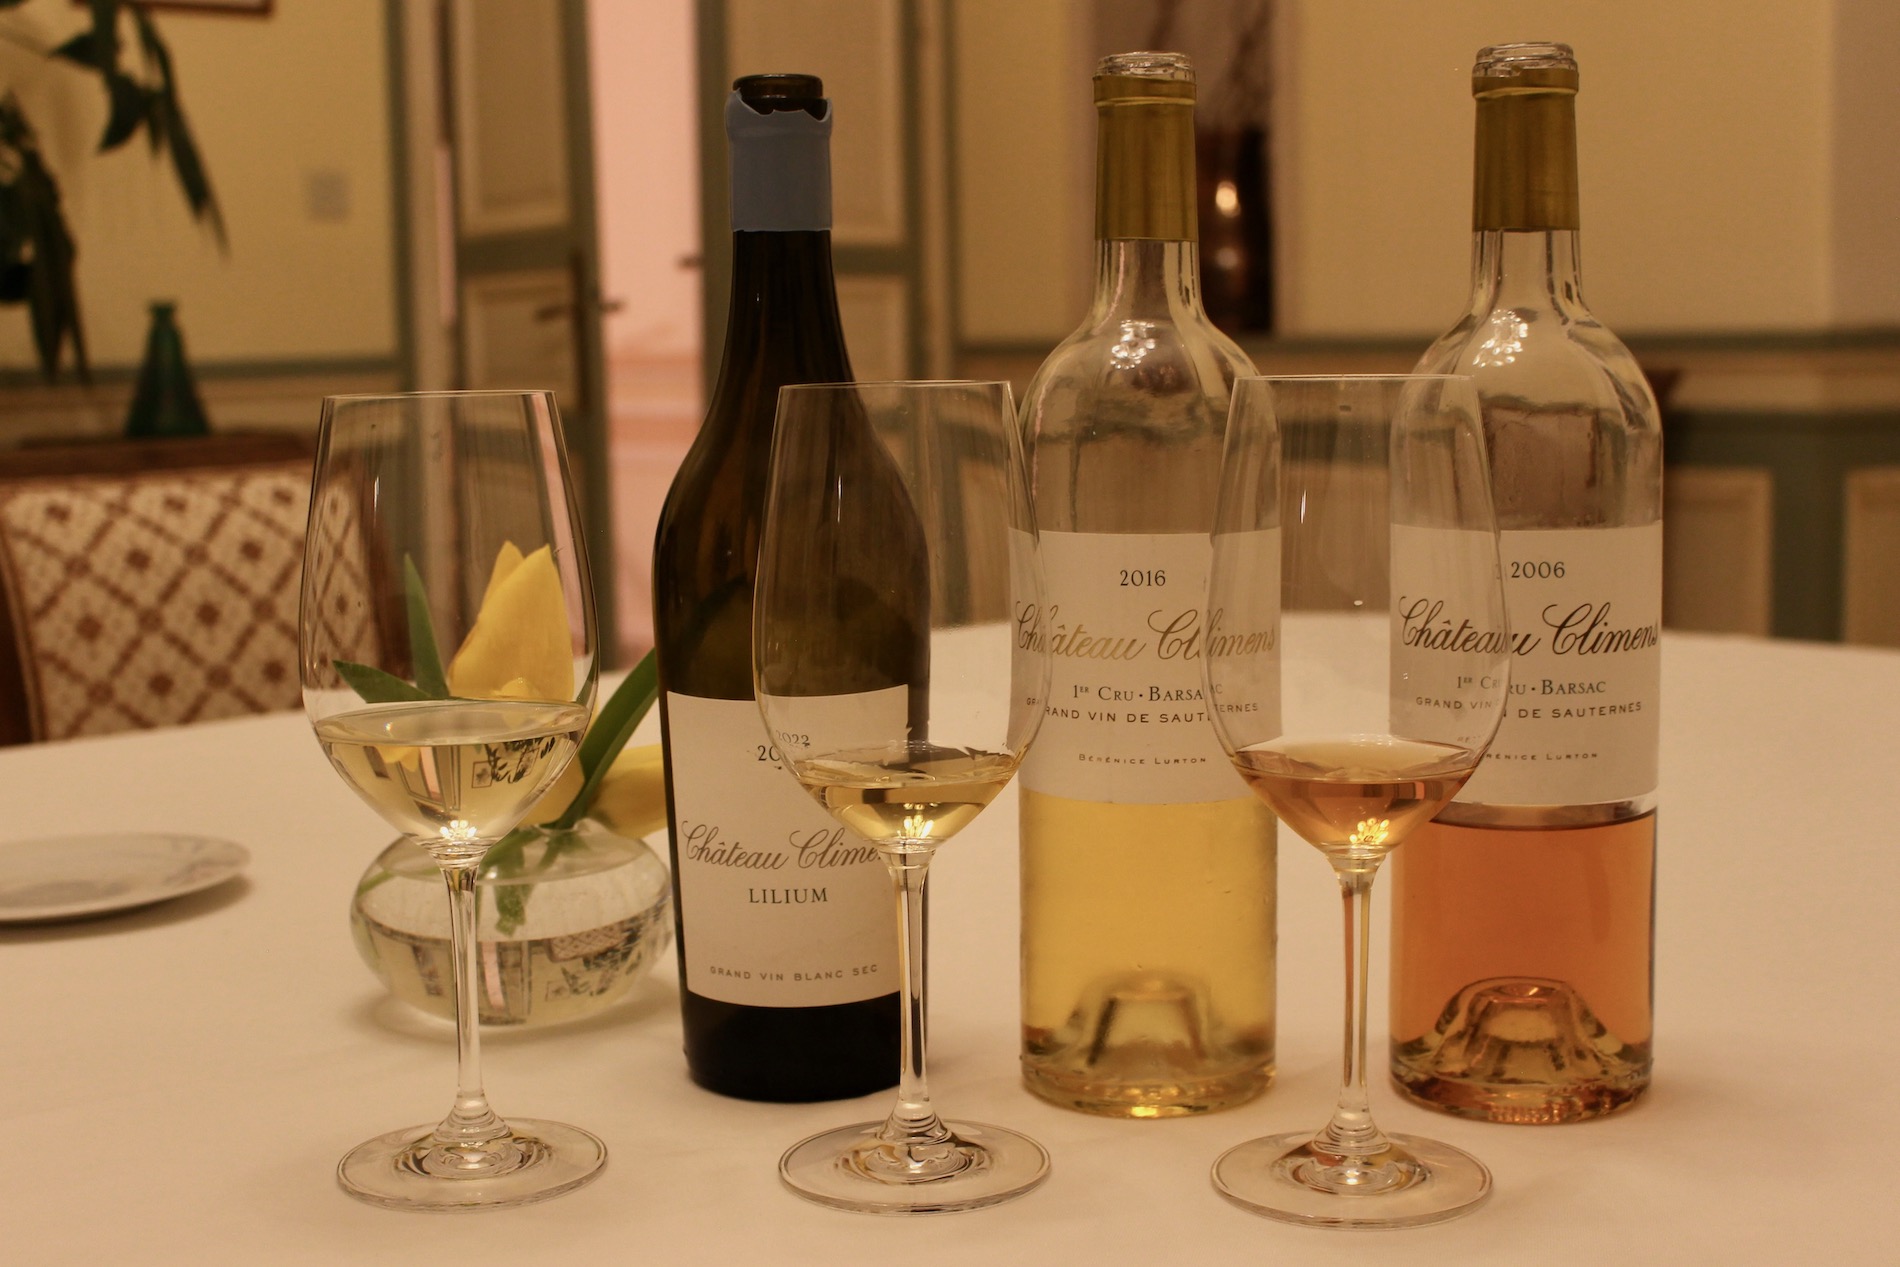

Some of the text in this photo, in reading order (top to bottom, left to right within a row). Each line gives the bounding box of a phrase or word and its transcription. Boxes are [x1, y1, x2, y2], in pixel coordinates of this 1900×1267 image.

[1119, 569, 1167, 587] 2016
[1510, 561, 1566, 579] 2006
[1147, 607, 1276, 661] Climens
[1399, 595, 1659, 656] Château Climens
[1088, 711, 1116, 722] VIN
[1126, 713, 1149, 723] DE
[1415, 697, 1463, 710] GRAND
[1518, 708, 1543, 719] DE
[1551, 701, 1642, 719] SAUTERNES
[681, 820, 882, 870] Château Clime
[749, 888, 828, 904] LILIUM
[710, 964, 878, 981] GRAND VIN BLANC SEC
